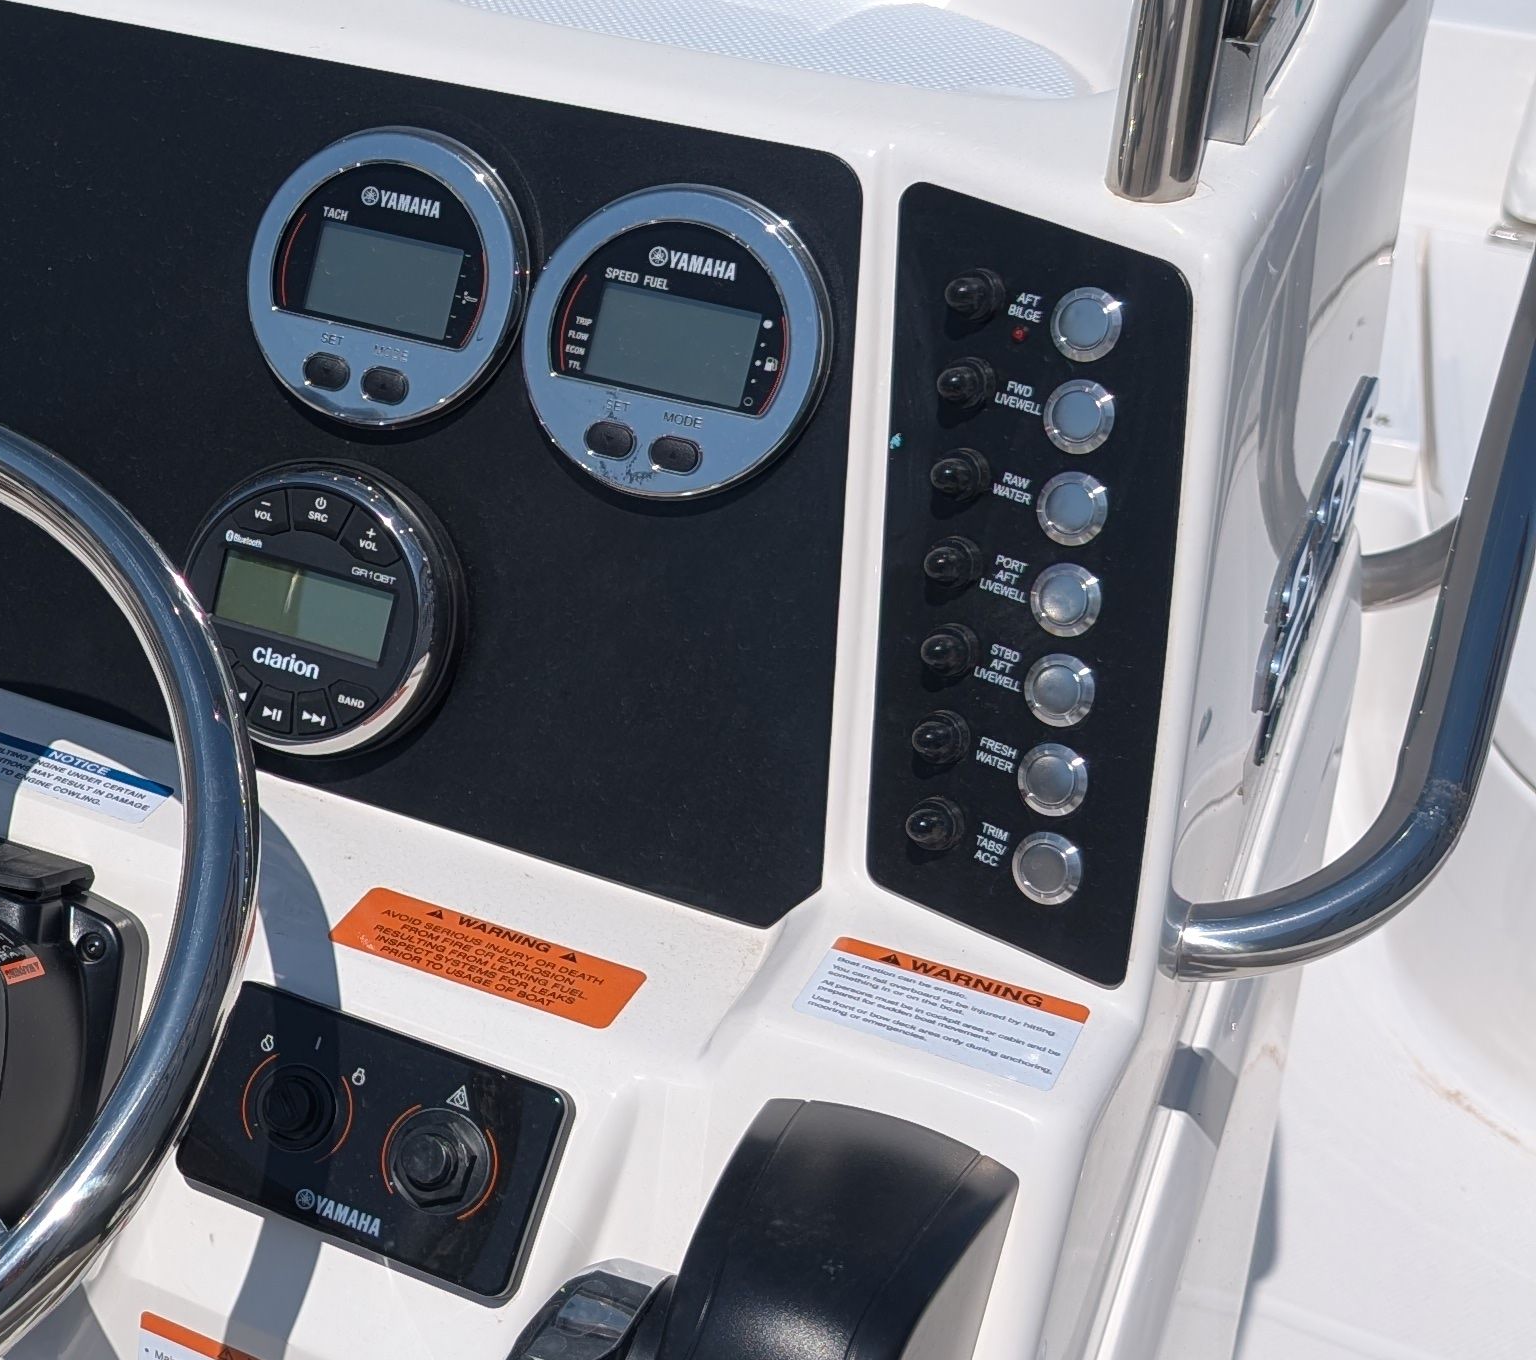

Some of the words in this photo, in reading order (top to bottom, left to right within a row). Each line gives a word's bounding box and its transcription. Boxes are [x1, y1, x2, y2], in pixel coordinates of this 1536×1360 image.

[322, 206, 350, 221] TACH
[380, 189, 441, 219] YAMAHA
[667, 249, 737, 282] YAMAHA
[605, 267, 640, 285] SPEED
[643, 275, 669, 291] FUEL
[1016, 292, 1042, 307] AFT
[575, 315, 593, 326] TRIP
[1007, 304, 1043, 323] BILGE
[320, 332, 345, 346] SET
[567, 329, 589, 341] FLOW
[565, 343, 585, 355] ECON
[568, 360, 581, 370] TTL
[1007, 381, 1033, 397] FWD
[606, 399, 631, 412] SET
[663, 411, 704, 429] MODE
[994, 392, 1042, 415] LIVEWELL
[1002, 472, 1032, 489] RAW
[992, 482, 1033, 506] WATER
[254, 509, 273, 522] VOL
[308, 510, 329, 523] SRC
[233, 532, 263, 549] Bluetooth
[358, 539, 378, 552] VOL
[995, 554, 1028, 574] PORT
[994, 570, 1020, 586] AFT
[979, 578, 1027, 604] LIVEWELL
[252, 645, 320, 680] clarion
[990, 644, 1021, 663] STBD
[990, 658, 1014, 674] AFT
[973, 666, 1021, 693] LIVEWELL
[337, 694, 365, 709] BAND
[980, 736, 1018, 759] FRESH
[46, 750, 112, 776] NOTICE
[975, 749, 1014, 774] WATER
[13, 772, 53, 789] ENGINE
[51, 784, 103, 806] COWLING.
[27, 757, 67, 773] ENGINE
[66, 770, 103, 785] UNDER
[101, 781, 147, 799] CERTAIN
[30, 768, 54, 779] MAY
[52, 775, 93, 792] RESULT
[91, 788, 105, 796] IN
[103, 792, 150, 811] DAMAGE
[981, 822, 1009, 842] TRIM
[975, 835, 1006, 855] TABS/
[974, 849, 1000, 867] ACC
[455, 916, 553, 953] WARNING
[380, 908, 423, 926] AVOID
[422, 922, 483, 945] SERIOUS
[483, 942, 533, 962] INJURY
[533, 958, 556, 970] OR
[556, 966, 605, 985] DEATH
[399, 924, 441, 941] FROM
[440, 937, 473, 951] FIRE
[472, 948, 496, 959] OR
[496, 955, 576, 985] EXPLOSION
[372, 924, 447, 952] RESULTING
[447, 948, 490, 966] FROM
[489, 962, 550, 986] LEAKING
[550, 983, 590, 1000] FUEL.
[374, 934, 433, 957] INSPECT
[432, 953, 498, 979] SYSTEMS
[498, 974, 530, 989] FOR
[530, 985, 576, 1004] LEAKS
[378, 945, 423, 964] PRIOR
[422, 959, 445, 971] TO
[444, 966, 495, 987] USAGE
[494, 983, 515, 994] OF
[515, 990, 555, 1007] BOAT
[906, 959, 1046, 1007] WARNING
[315, 1194, 381, 1237] YAMAHA
